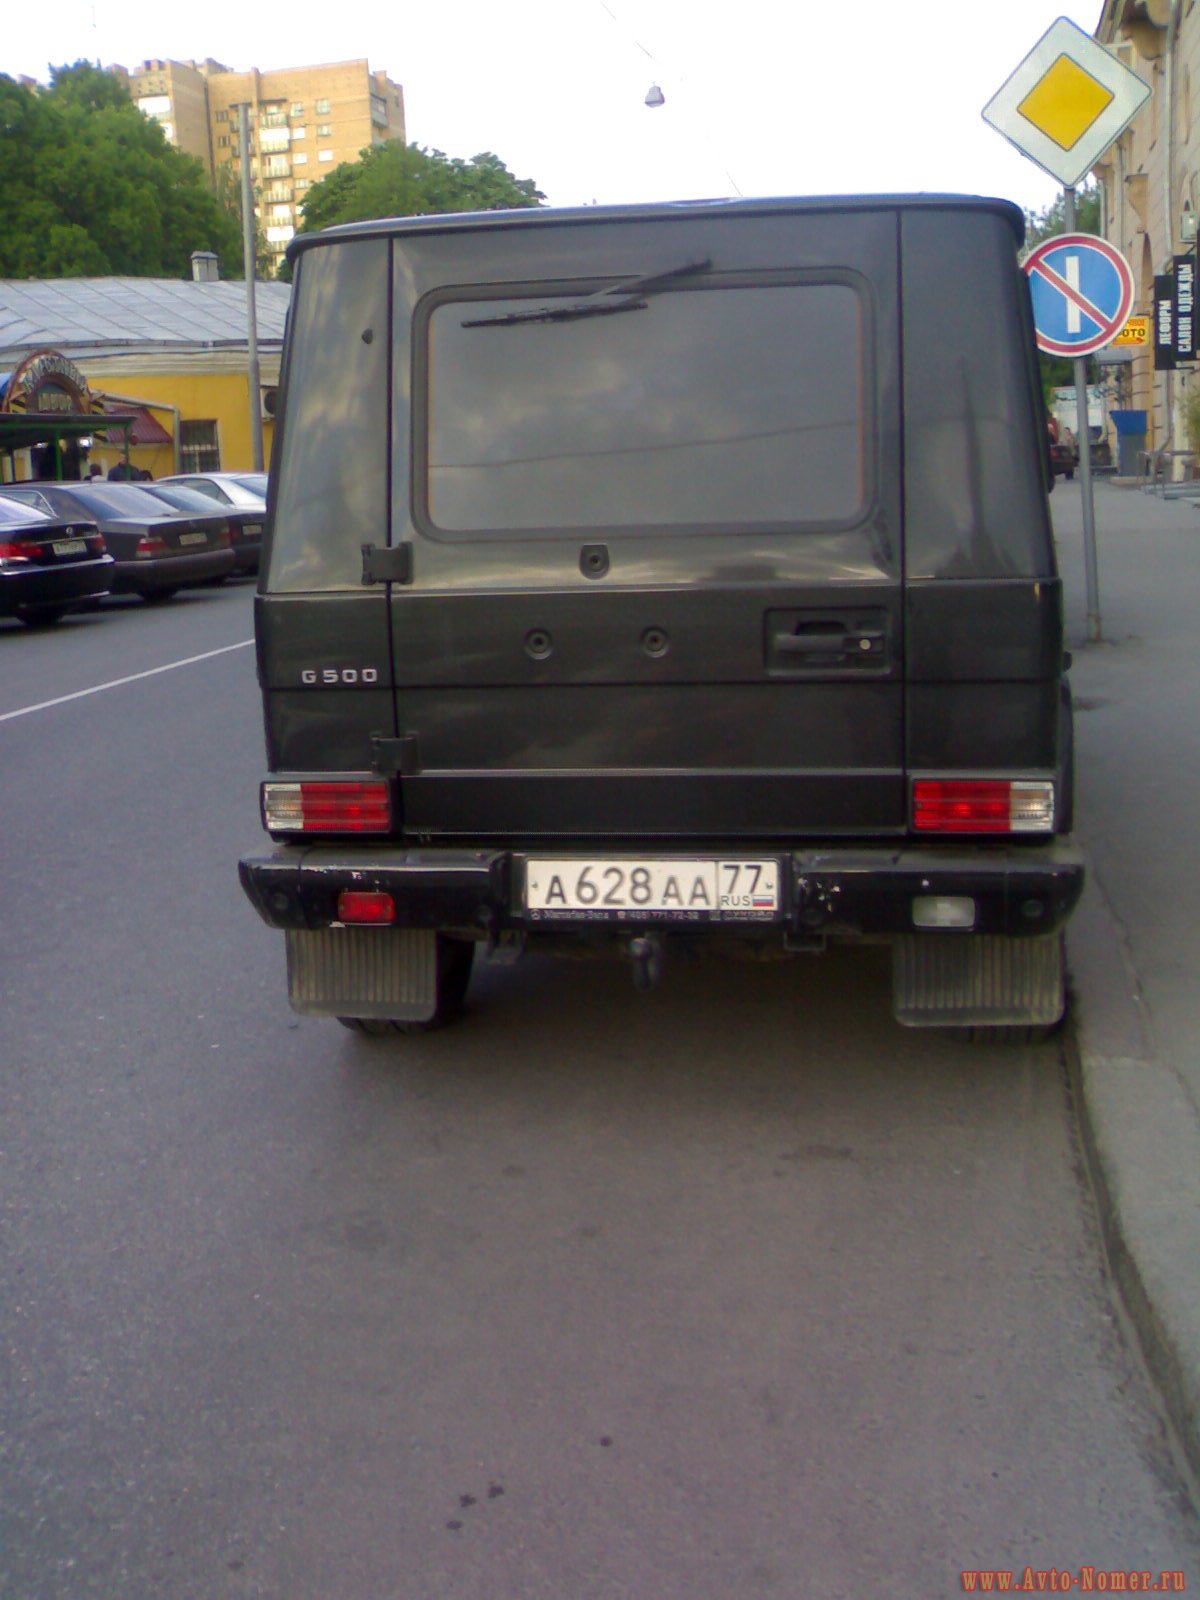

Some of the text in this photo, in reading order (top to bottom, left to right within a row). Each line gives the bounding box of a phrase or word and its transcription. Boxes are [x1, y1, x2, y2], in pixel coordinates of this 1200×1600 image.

[1158, 299, 1172, 345] ЛЕФОРМ
[1177, 263, 1193, 353] САЛОН ОДЕЖДЫ
[1120, 328, 1146, 338] ОТО
[722, 864, 762, 895] 77
[721, 895, 750, 907] RUS
